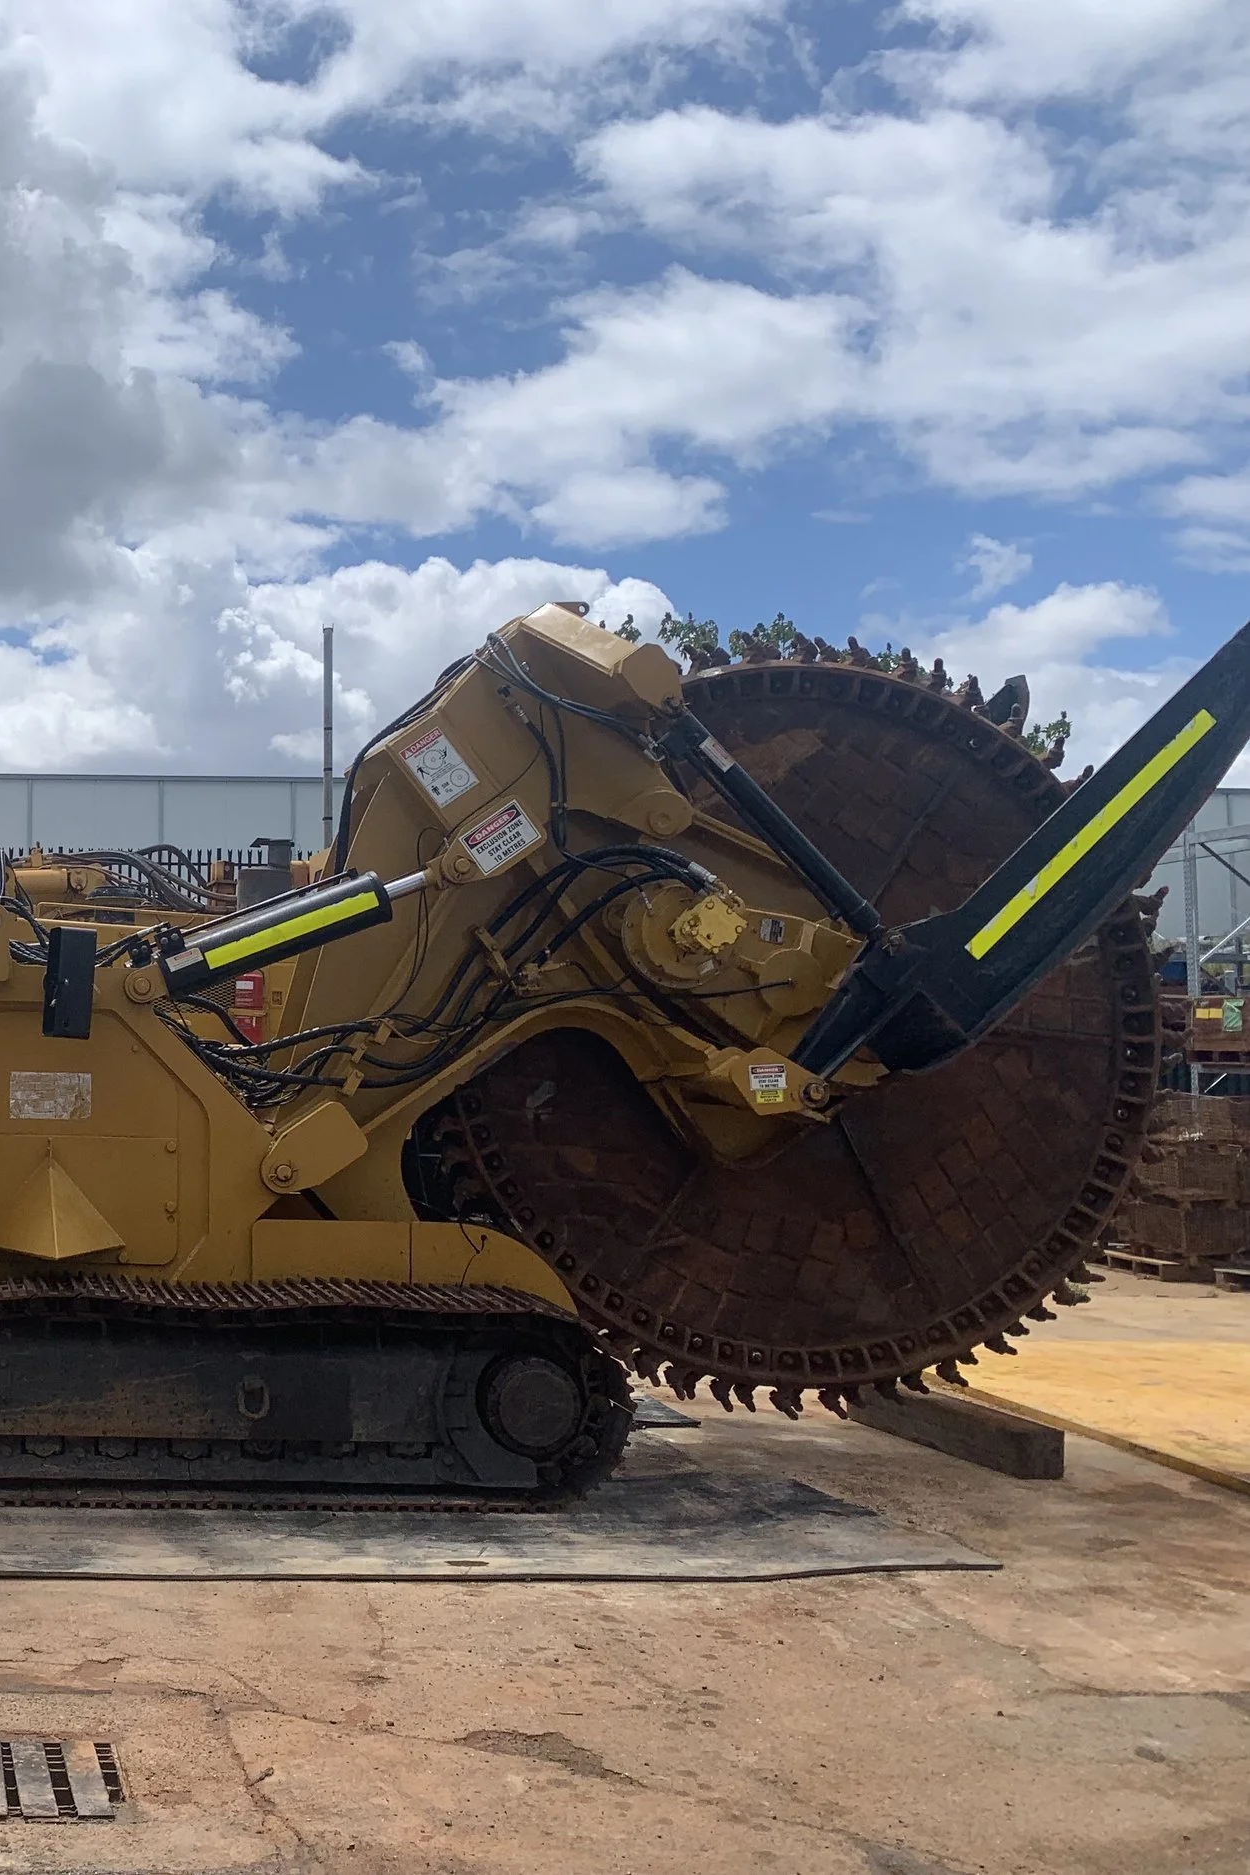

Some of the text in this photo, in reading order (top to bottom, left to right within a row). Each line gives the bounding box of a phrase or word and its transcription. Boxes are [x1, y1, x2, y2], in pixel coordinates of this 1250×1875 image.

[410, 730, 441, 753] DANGER
[475, 814, 510, 841] DANGER
[475, 819, 524, 854] EXCLUSION ZONE
[487, 831, 522, 857] STAY CLEAR
[494, 839, 526, 863] 10 METRES
